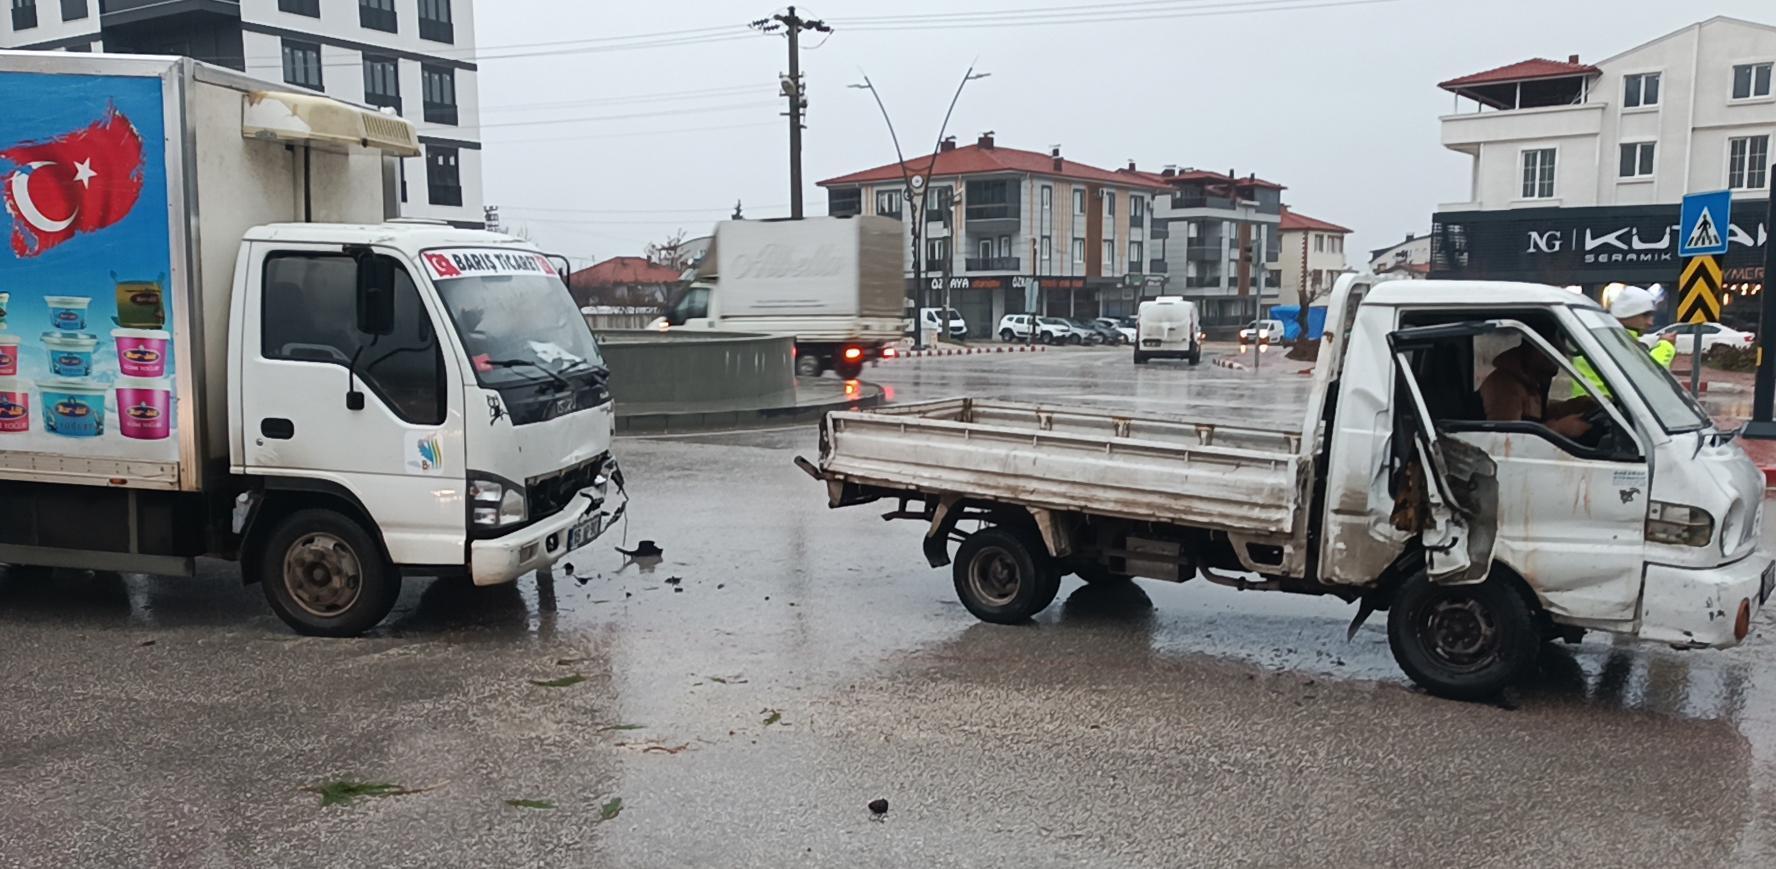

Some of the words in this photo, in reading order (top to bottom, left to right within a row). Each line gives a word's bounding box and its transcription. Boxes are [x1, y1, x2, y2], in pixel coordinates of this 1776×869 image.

[1527, 231, 1563, 254] NG
[453, 253, 497, 273] BARIŞ
[495, 253, 542, 272] TİCARET
[931, 277, 970, 290] ÖZAYA
